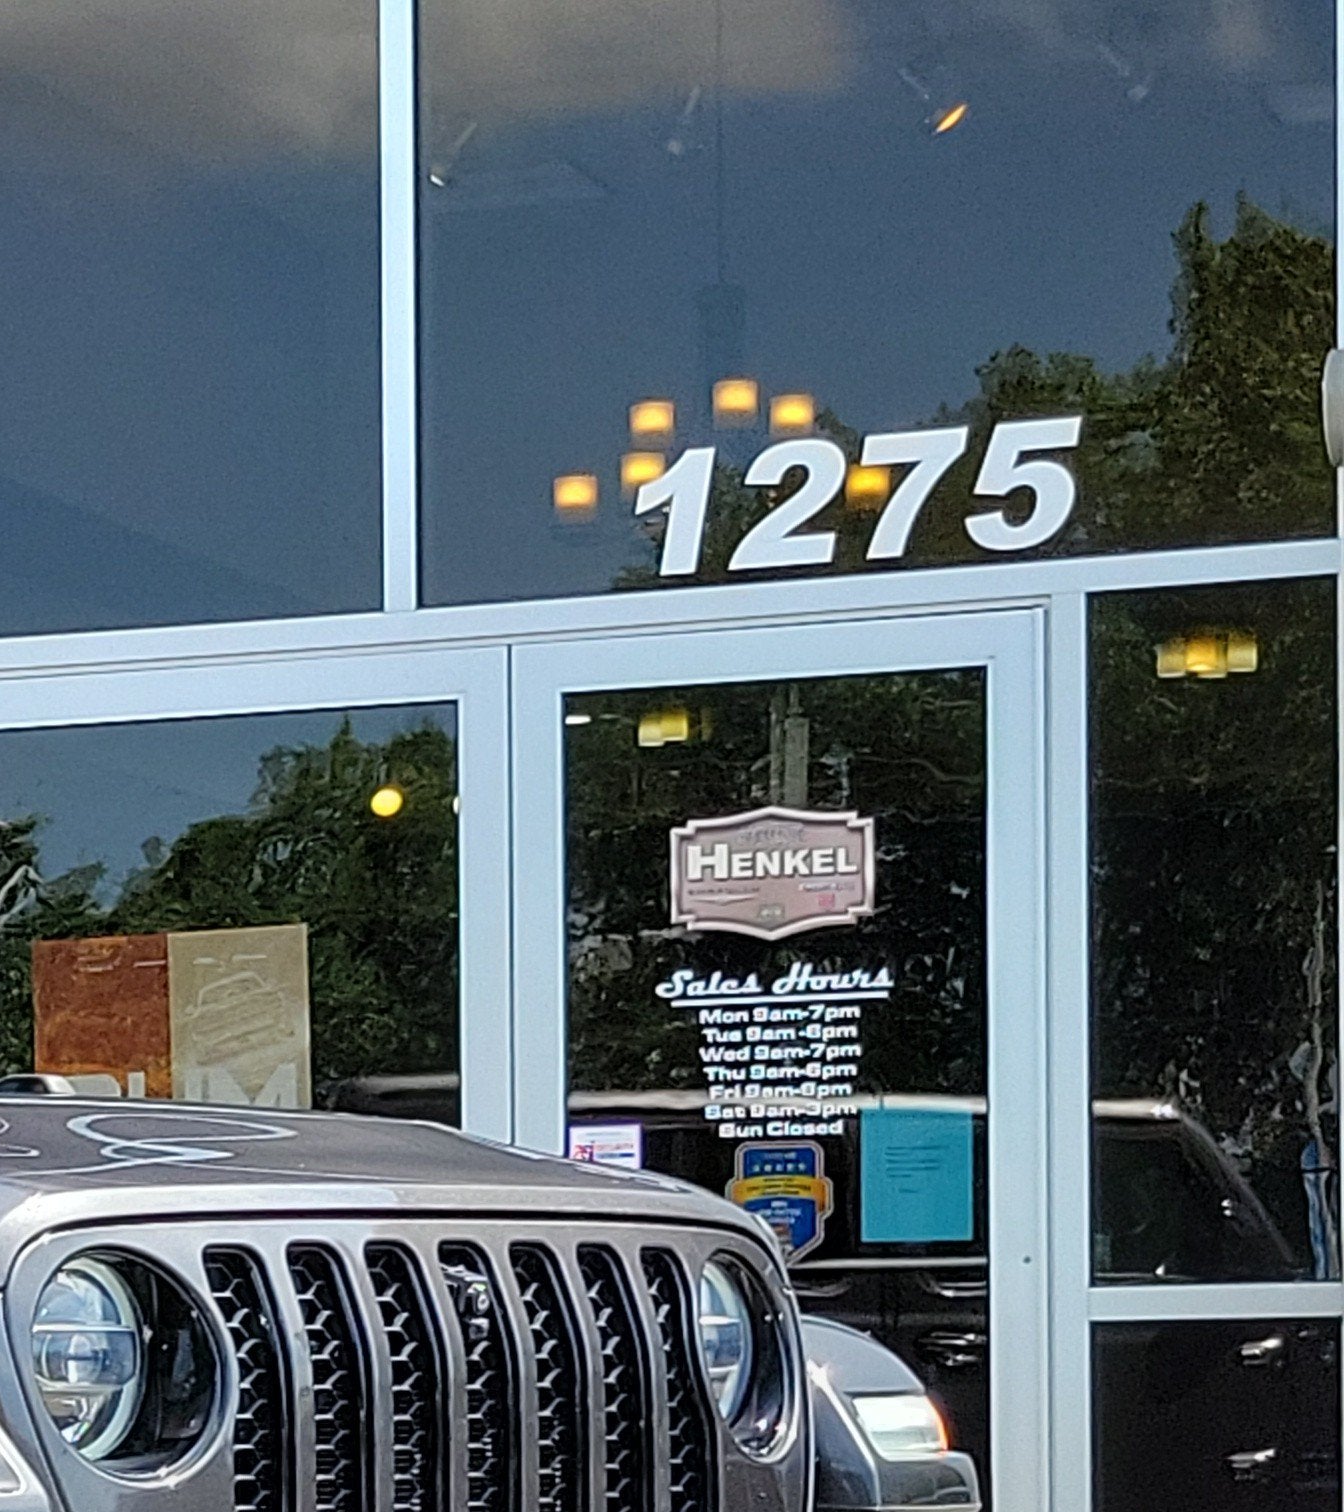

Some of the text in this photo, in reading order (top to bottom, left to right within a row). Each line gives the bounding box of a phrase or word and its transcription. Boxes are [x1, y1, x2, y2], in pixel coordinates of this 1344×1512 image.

[635, 416, 1082, 577] 1275
[686, 843, 859, 881] HENKEL
[655, 961, 894, 998] Sales Hours
[699, 1004, 860, 1024] Mon 9am-7pm
[702, 1028, 742, 1042] Tue
[699, 1043, 861, 1062] Wed 9am-7pm
[703, 1066, 746, 1081] Thu
[709, 1085, 742, 1100] Fri
[704, 1104, 746, 1119] Sat
[719, 1119, 844, 1138] Sun Closed
